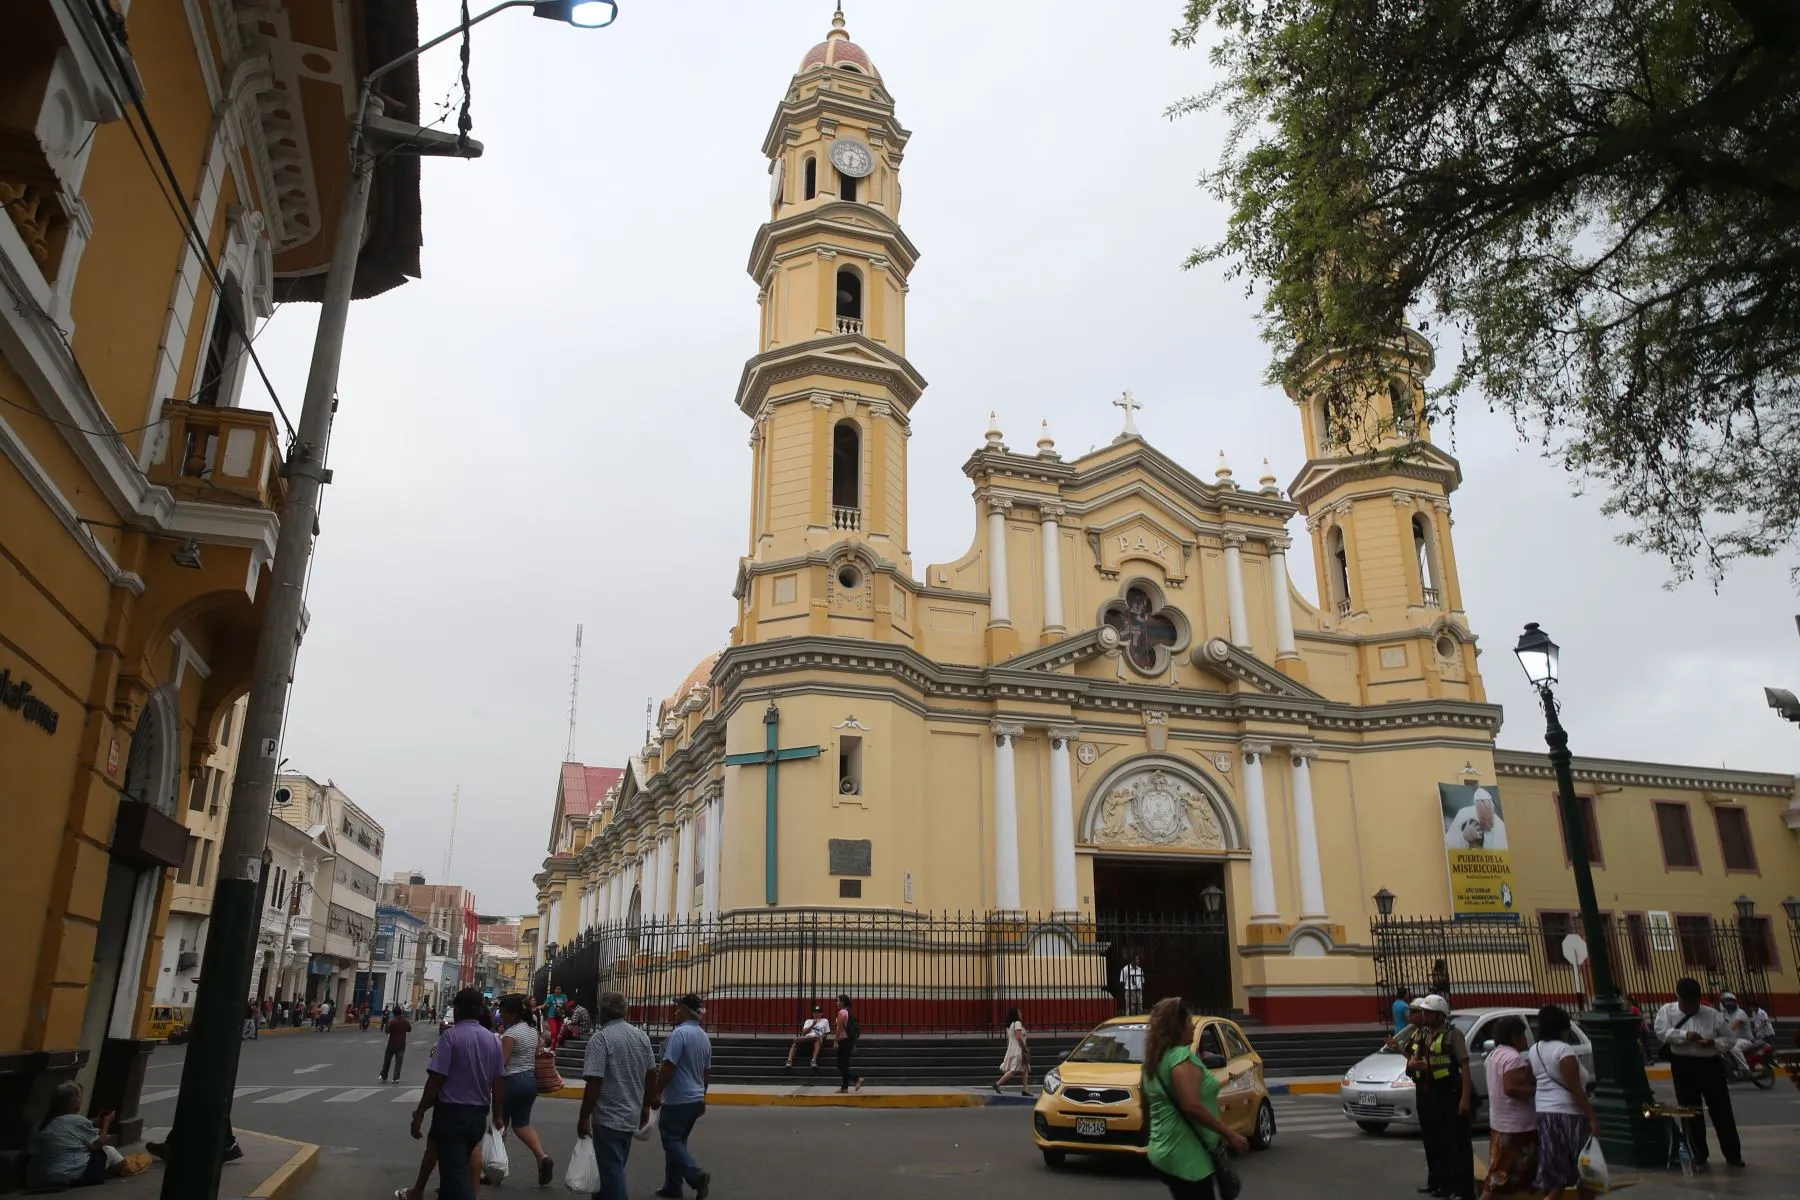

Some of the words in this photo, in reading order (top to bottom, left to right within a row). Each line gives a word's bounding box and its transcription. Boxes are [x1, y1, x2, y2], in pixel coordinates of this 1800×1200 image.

[1457, 854, 1484, 863] PUERTA
[1485, 855, 1495, 863] DE
[1495, 855, 1503, 863] LA
[1452, 863, 1510, 873] MISERICORDIA
